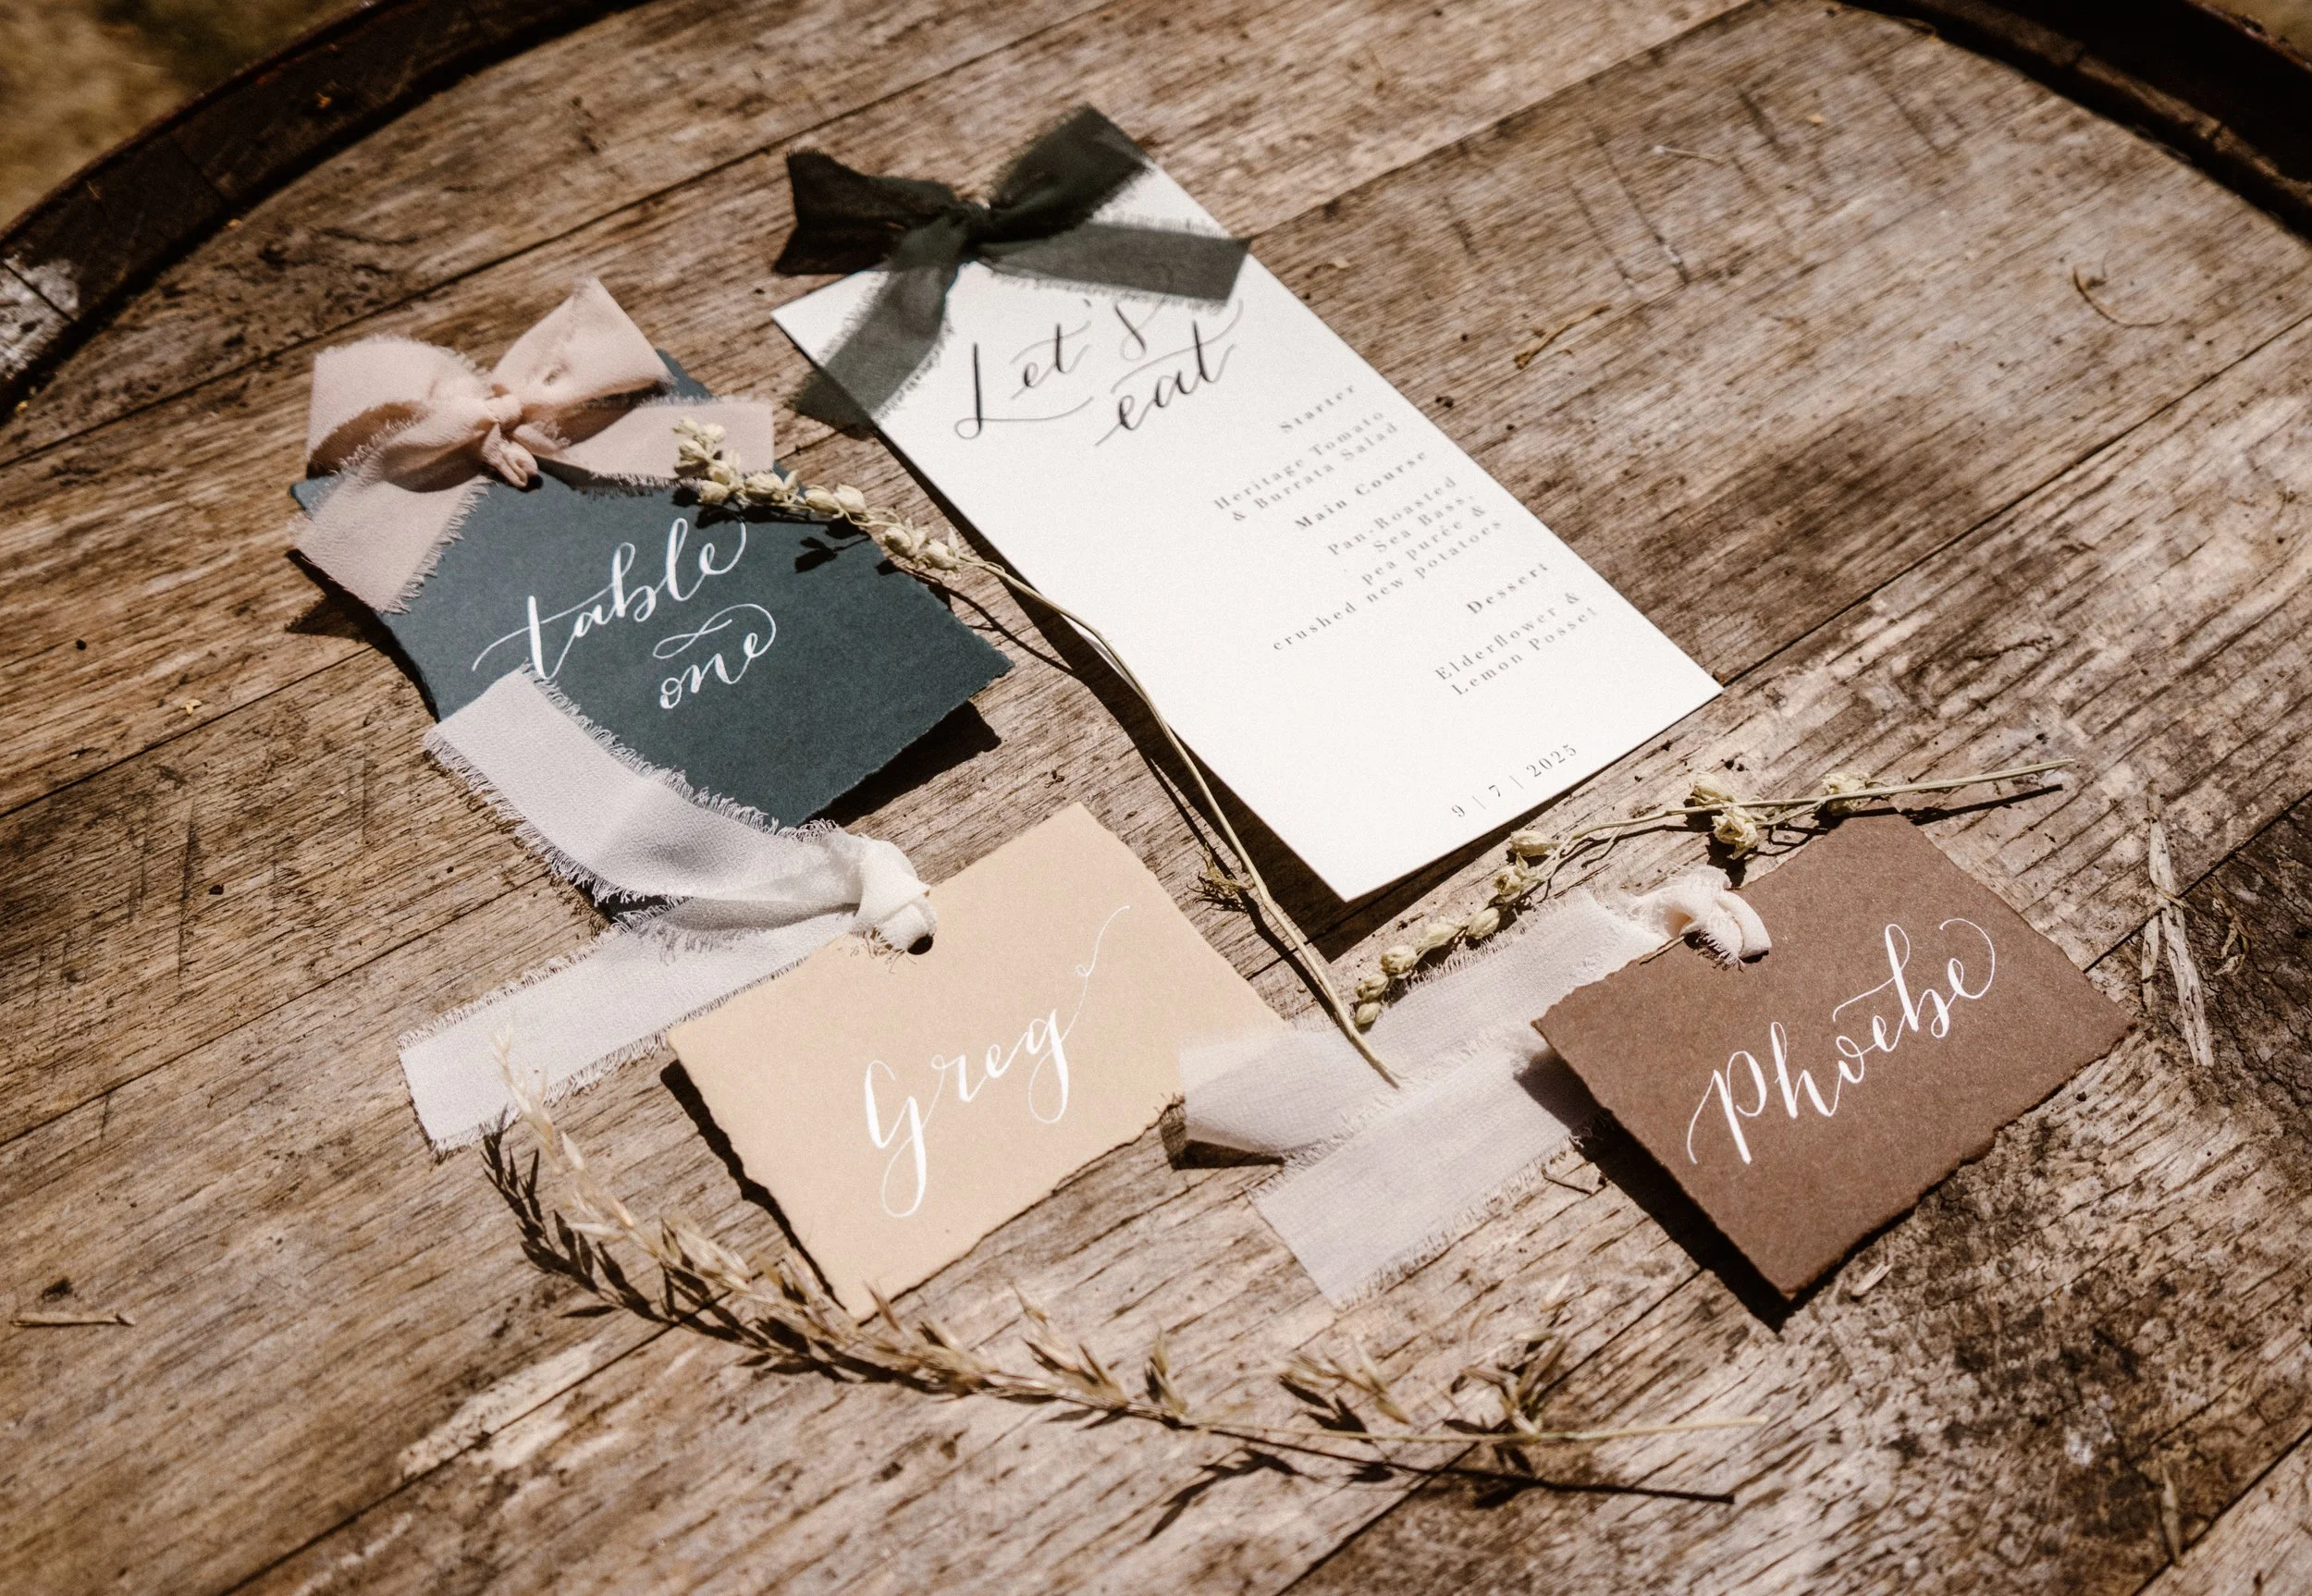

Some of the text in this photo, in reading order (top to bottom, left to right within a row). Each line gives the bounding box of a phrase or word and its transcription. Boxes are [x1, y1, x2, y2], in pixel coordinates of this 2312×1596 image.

[1095, 298, 1244, 446] eat
[1279, 385, 1355, 432] Starter
[1214, 411, 1384, 509] Heritage Tomato
[1232, 423, 1398, 522] & Burrata Salad
[1295, 452, 1426, 531] Main Course
[1273, 520, 1501, 651] crushed new potatoes
[1361, 505, 1486, 585] pea purée &
[1373, 528, 1412, 553] Sea
[472, 518, 746, 680] table
[1466, 562, 1549, 614] Dessert
[652, 604, 777, 709] one
[1434, 592, 1580, 681] Elderflower &
[1451, 606, 1598, 695] Lemon Posset
[1526, 743, 1577, 778] 2025
[864, 905, 1130, 1218] Greg
[1687, 918, 1995, 1165] Phoebe
